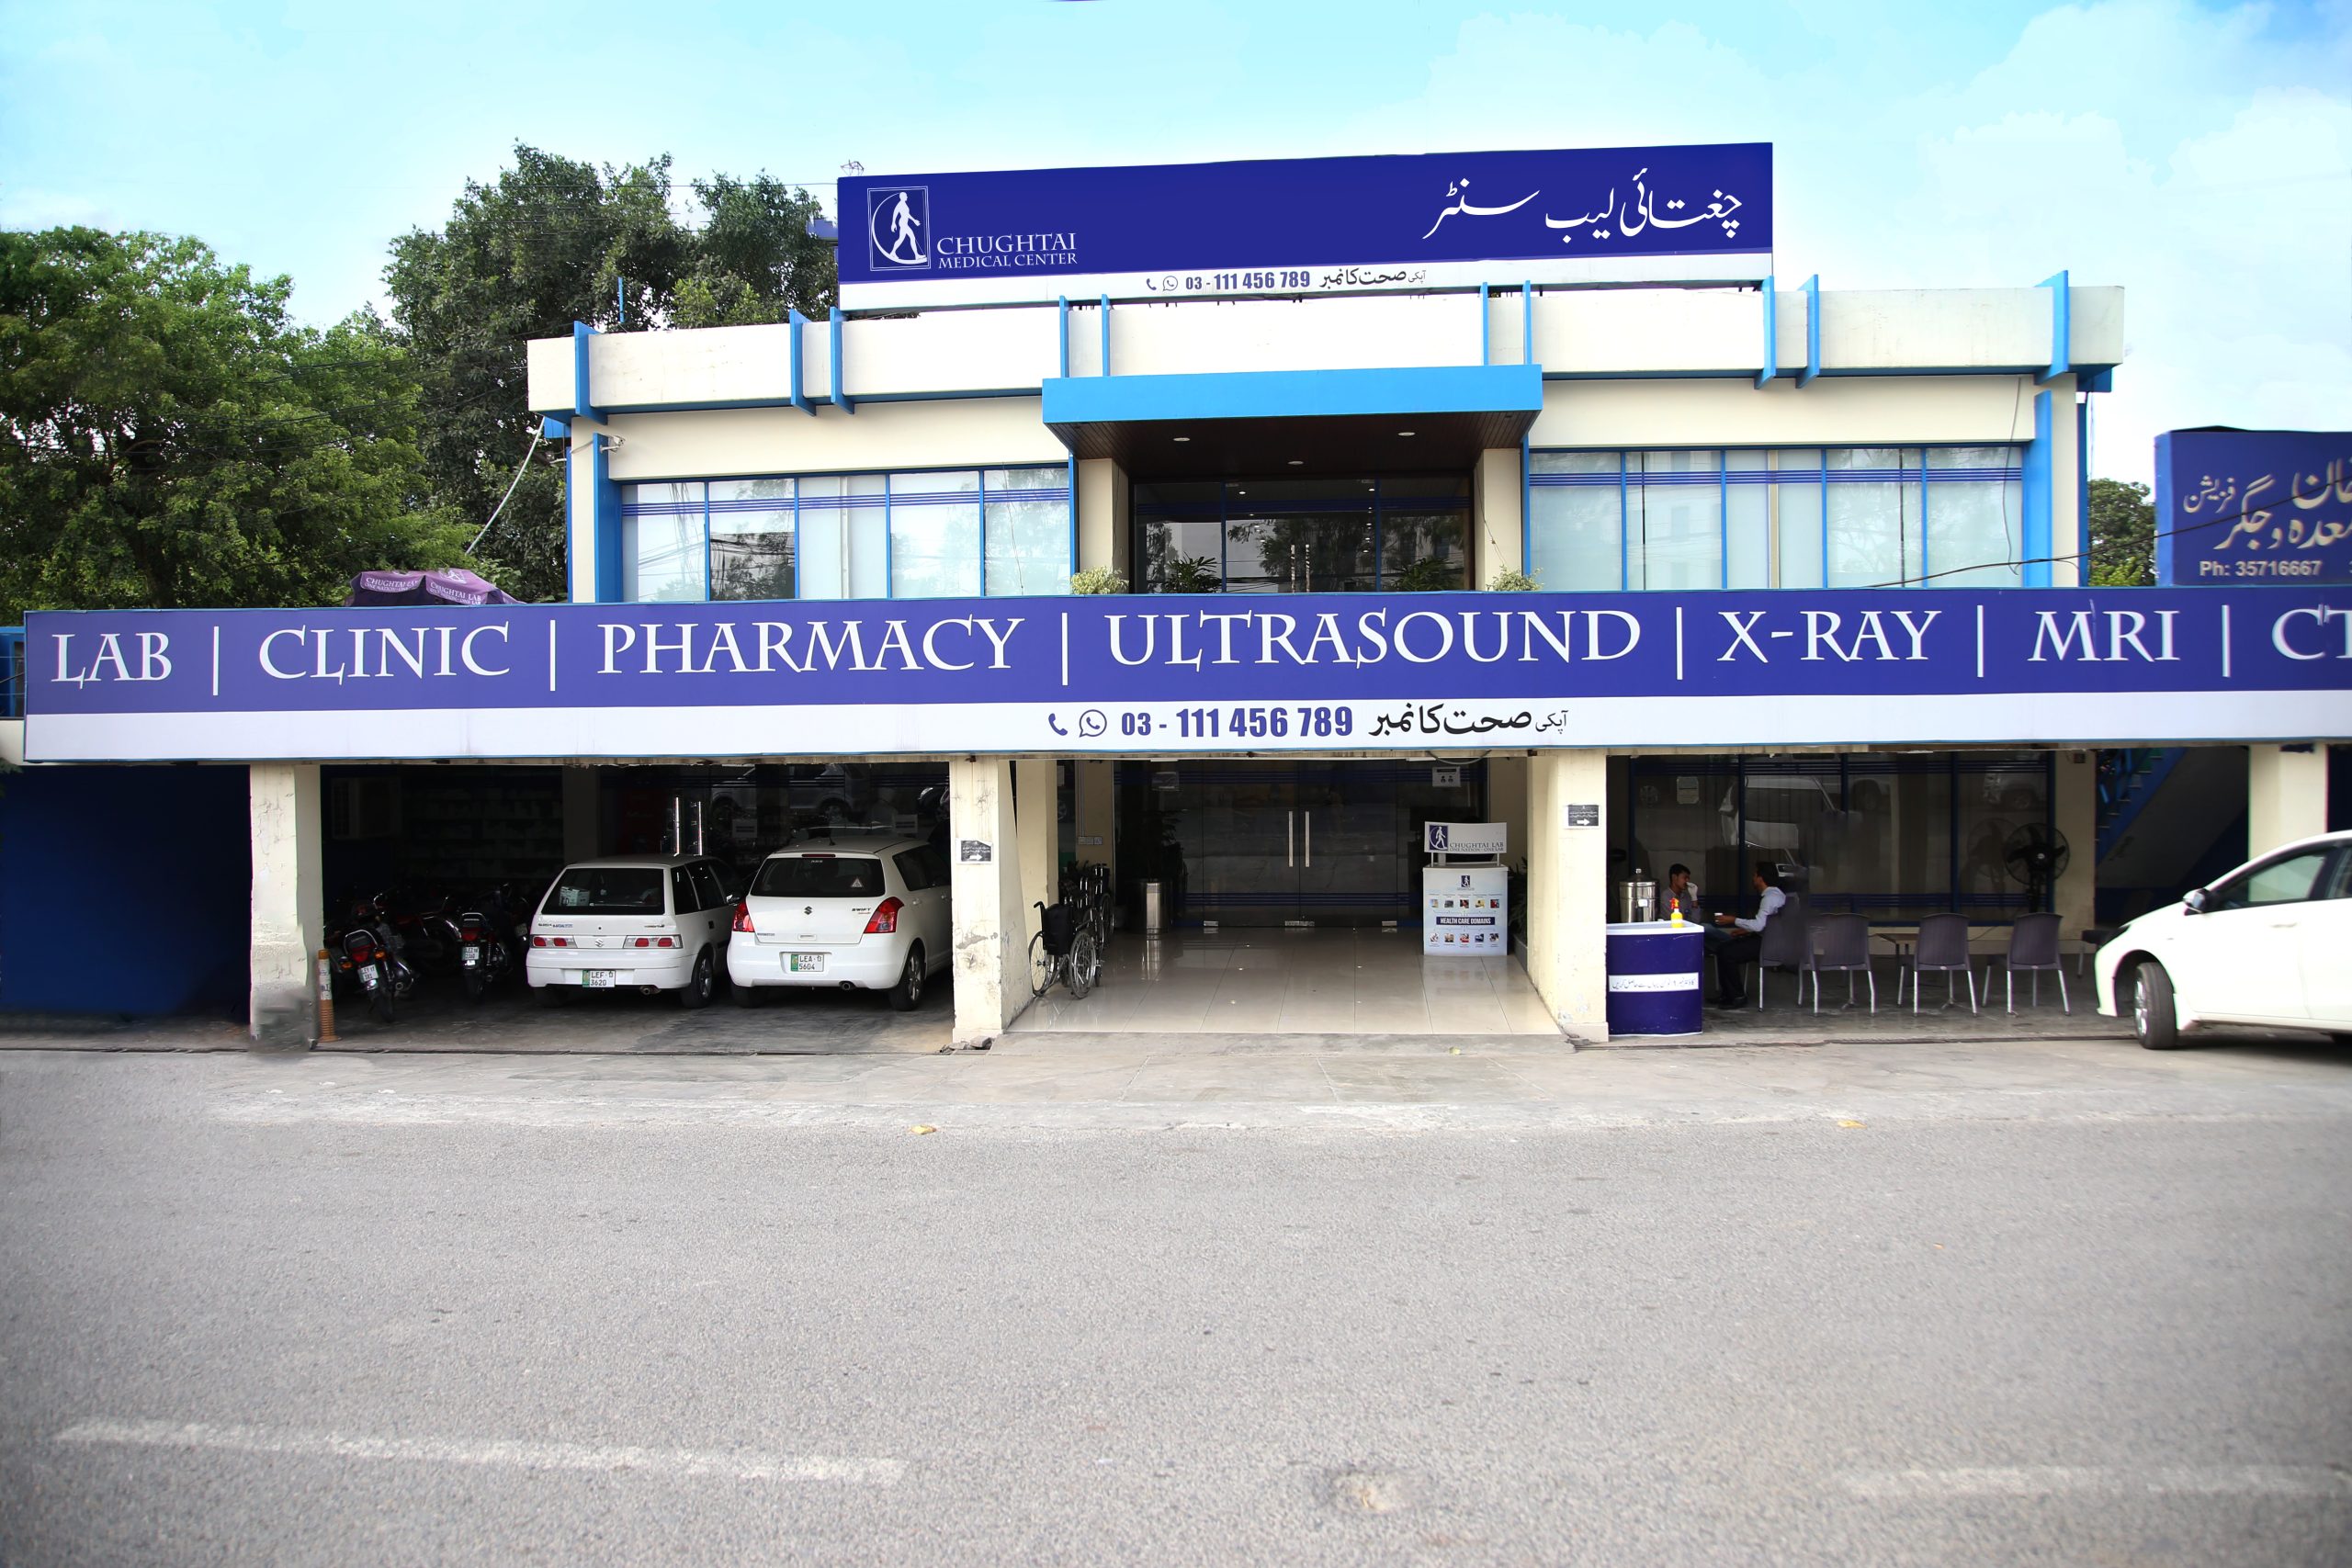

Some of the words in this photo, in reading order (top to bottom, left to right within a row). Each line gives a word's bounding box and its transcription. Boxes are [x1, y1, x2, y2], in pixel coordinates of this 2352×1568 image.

[1422, 177, 1540, 240] سنٹر
[1545, 187, 1614, 243] لیب
[1620, 168, 1743, 238] چغتائی
[936, 232, 1077, 255] CHUGHTAI
[938, 254, 1012, 269] MEDICAL
[1014, 252, 1078, 266] CENTER
[1185, 276, 1203, 290] 03
[1214, 273, 1238, 290] 111
[1242, 271, 1275, 289] 456
[1280, 270, 1311, 288] 789
[1318, 269, 1345, 288] نمبر
[2199, 560, 2231, 576] Ph:
[2234, 559, 2323, 576] 35716667
[468, 593, 481, 602] LAB
[51, 632, 173, 690] LAB
[259, 624, 511, 685] CLINIC
[597, 614, 1025, 675] PHARMACY
[1103, 607, 1641, 672] ULTRASOUND
[1716, 609, 1942, 664] X-RAY
[2027, 610, 2180, 661] MRI
[1121, 712, 1151, 736] 03
[1175, 708, 1219, 738] 111
[1228, 706, 1288, 738] 456
[1297, 705, 1353, 737] 789
[1368, 702, 1415, 736] نمبر
[1444, 710, 1532, 734] صحت
